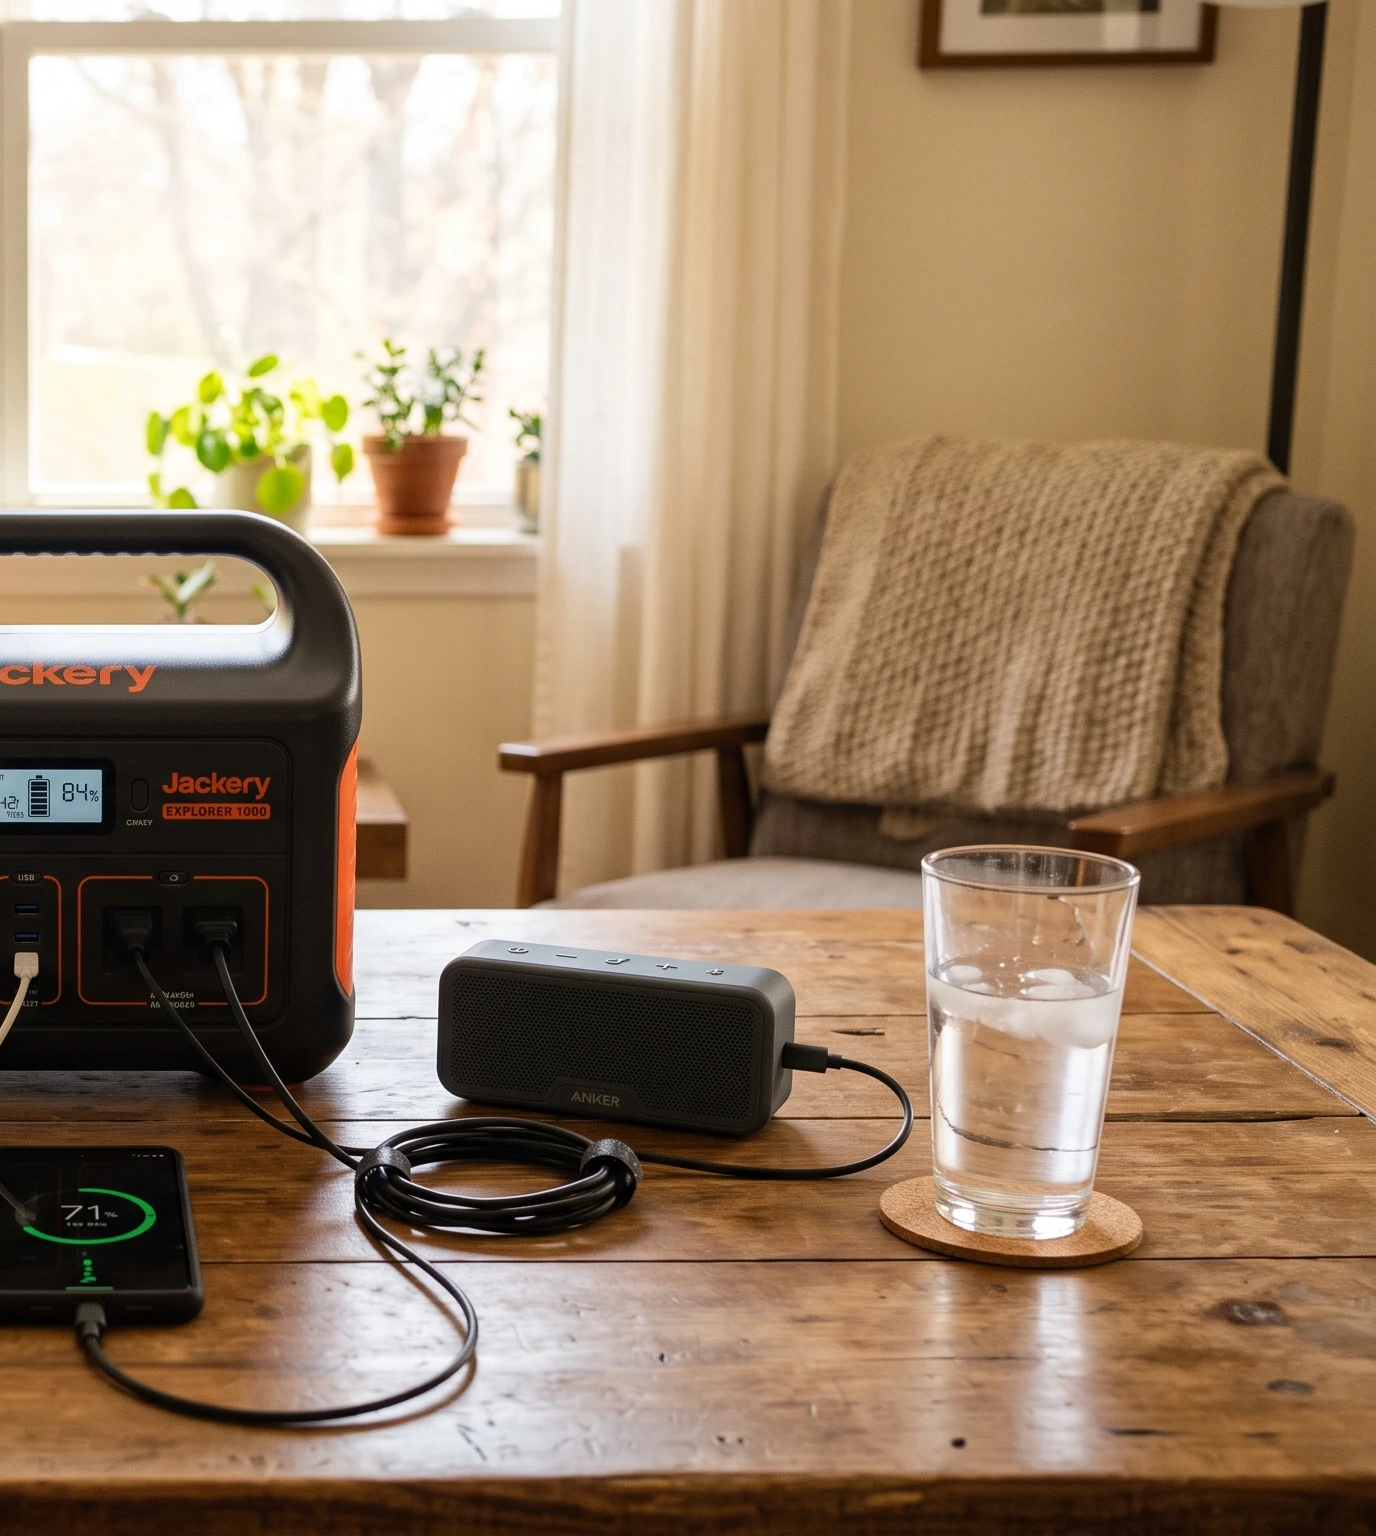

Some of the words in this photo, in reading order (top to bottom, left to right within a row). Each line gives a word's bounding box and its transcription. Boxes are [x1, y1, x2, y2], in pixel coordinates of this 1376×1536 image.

[62, 782, 100, 802] 84%
[161, 772, 272, 801] Jackery
[166, 806, 232, 817] EXPLORER
[236, 806, 267, 817] 1000
[17, 873, 35, 881] USB
[570, 1090, 620, 1108] ANKER
